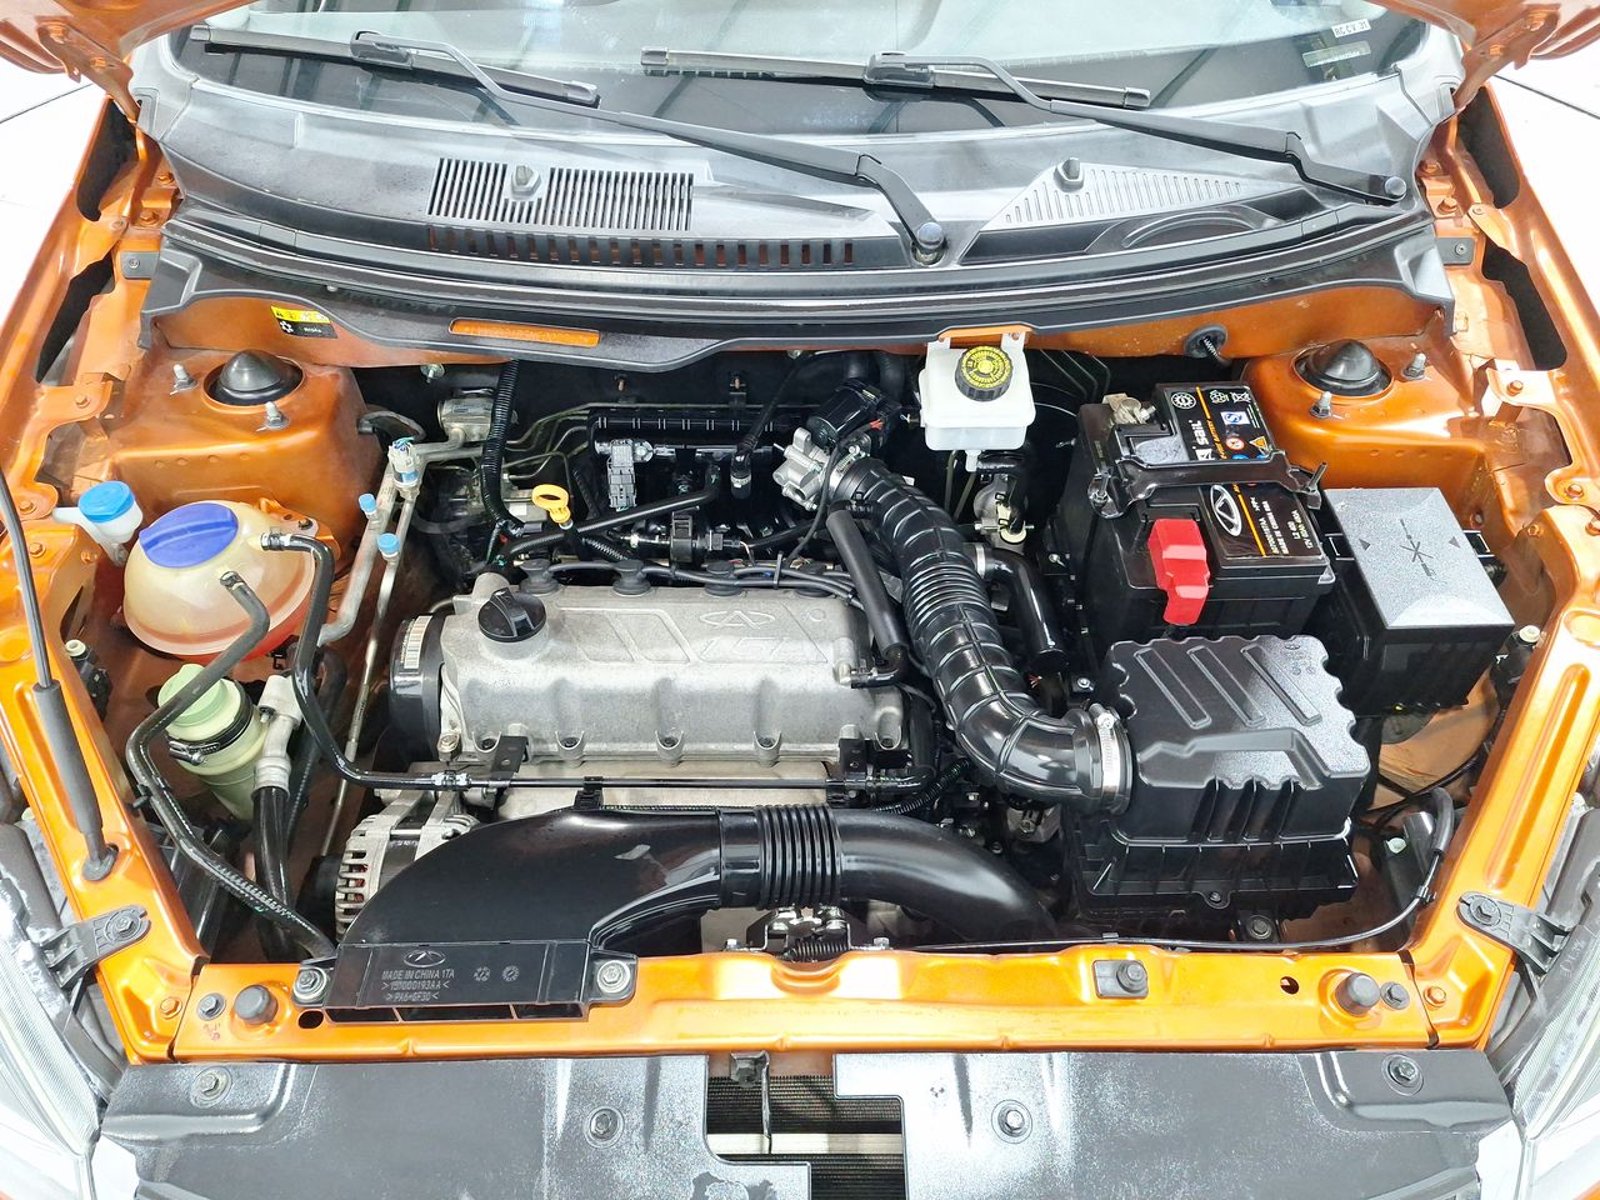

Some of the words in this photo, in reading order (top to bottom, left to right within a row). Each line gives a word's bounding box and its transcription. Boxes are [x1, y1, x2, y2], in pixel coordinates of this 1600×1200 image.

[381, 969, 403, 980] MADE
[404, 969, 415, 980] IN
[414, 969, 440, 980] CHINA
